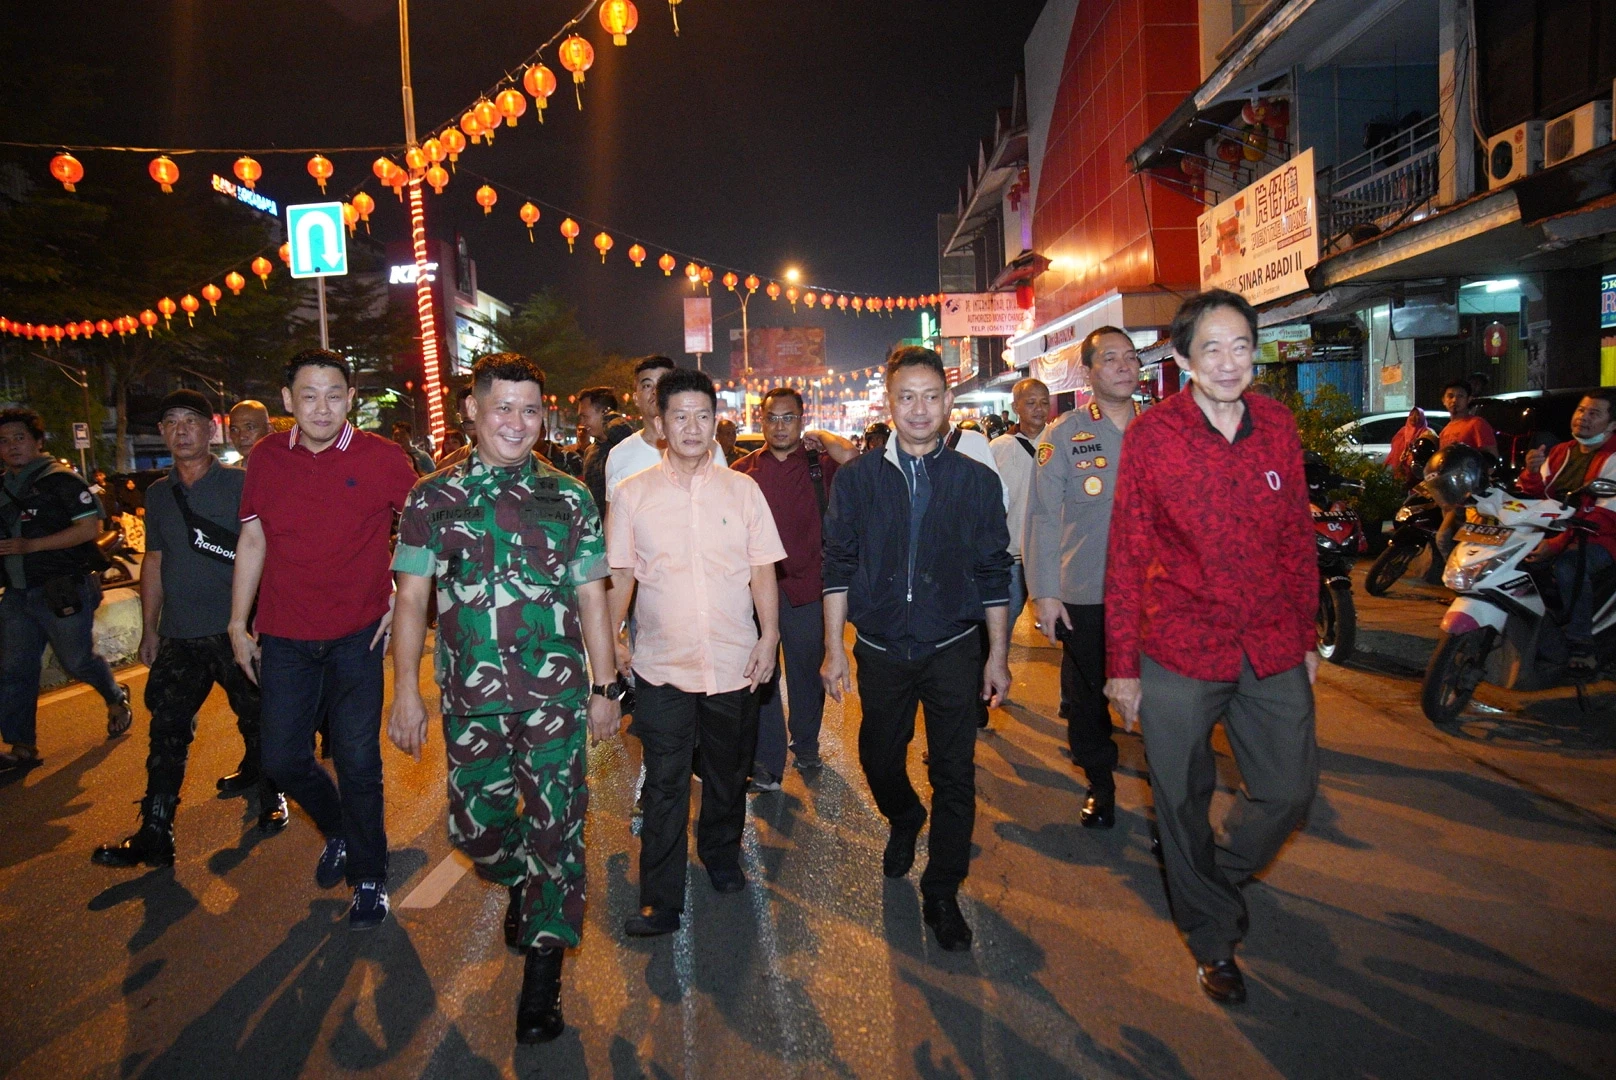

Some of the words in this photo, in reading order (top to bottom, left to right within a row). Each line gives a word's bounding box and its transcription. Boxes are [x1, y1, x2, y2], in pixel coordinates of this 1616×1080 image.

[1515, 145, 1524, 154] LG
[389, 262, 439, 284] KFC
[1238, 267, 1263, 293] SINAR
[1265, 253, 1293, 283] ABADI
[1295, 250, 1302, 272] II
[967, 314, 991, 323] AUTHORIZED
[992, 313, 1007, 322] MONEY
[1008, 312, 1025, 322] CHANGE
[1072, 443, 1103, 455] ADHE
[194, 537, 236, 560] Reebok
